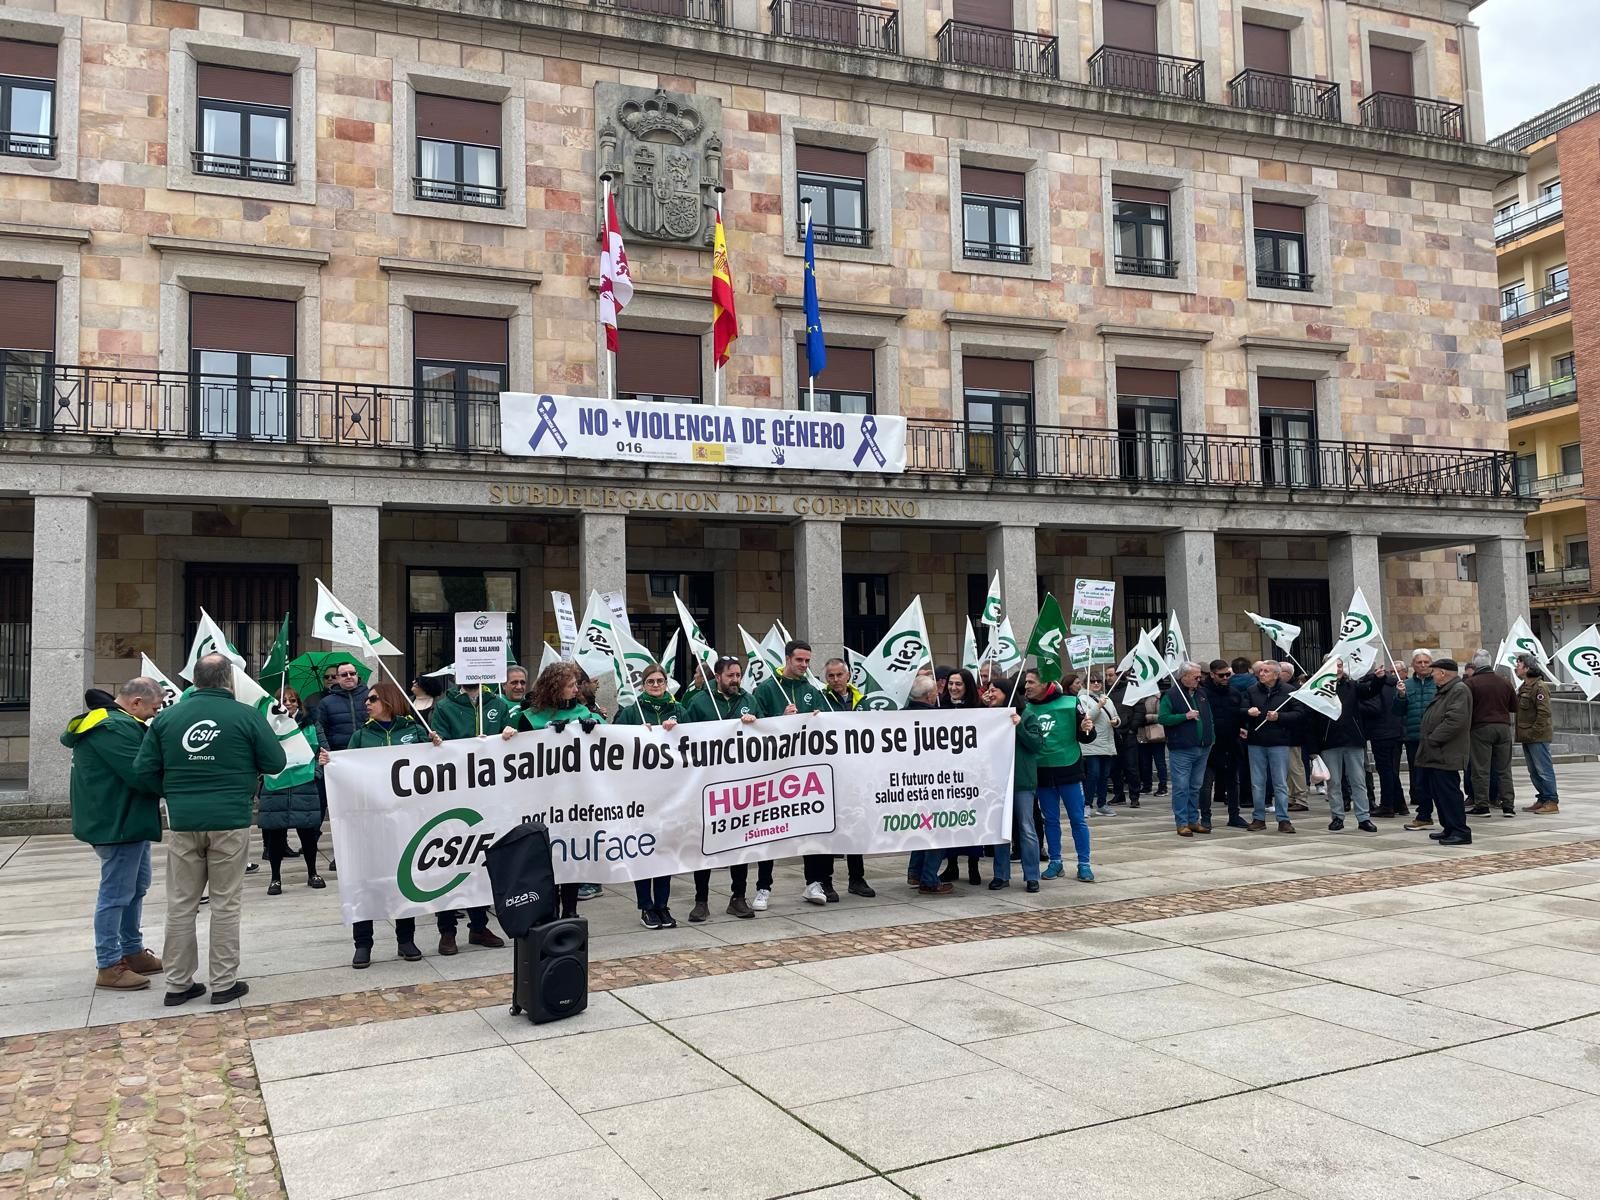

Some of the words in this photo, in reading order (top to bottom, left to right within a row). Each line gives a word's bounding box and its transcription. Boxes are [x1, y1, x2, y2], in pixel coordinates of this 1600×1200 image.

[579, 408, 608, 436] NO
[612, 419, 621, 428] +
[626, 410, 736, 443] VIOLENCIA
[742, 418, 766, 445] DE
[772, 415, 844, 449] GÉNERO
[616, 441, 642, 453] 016
[488, 484, 720, 510] SUBDELEGACION
[736, 494, 784, 513] DEL
[793, 496, 920, 518] GOBIERNO
[391, 758, 457, 797] Con
[467, 752, 496, 788] la
[503, 738, 580, 783] salud
[590, 737, 624, 771] de
[633, 737, 674, 769] los
[678, 725, 838, 768] funcionarios
[845, 729, 874, 754] no
[881, 727, 907, 752] se
[913, 721, 977, 755] juega
[709, 772, 825, 816] HUELGA
[875, 789, 904, 803] salud
[907, 787, 929, 801] está
[931, 788, 944, 800] en
[946, 785, 979, 800] riesgo
[890, 773, 899, 786] El
[902, 772, 934, 786] futuro
[937, 770, 950, 784] de
[953, 770, 964, 783] tu
[550, 806, 564, 823] la
[568, 804, 624, 821] defensa
[626, 801, 645, 818] de
[711, 819, 726, 834] 13
[730, 814, 750, 830] DE
[753, 800, 825, 824] FEBRERO
[745, 823, 789, 841] ¡Súmate!
[417, 833, 495, 871] CSIF
